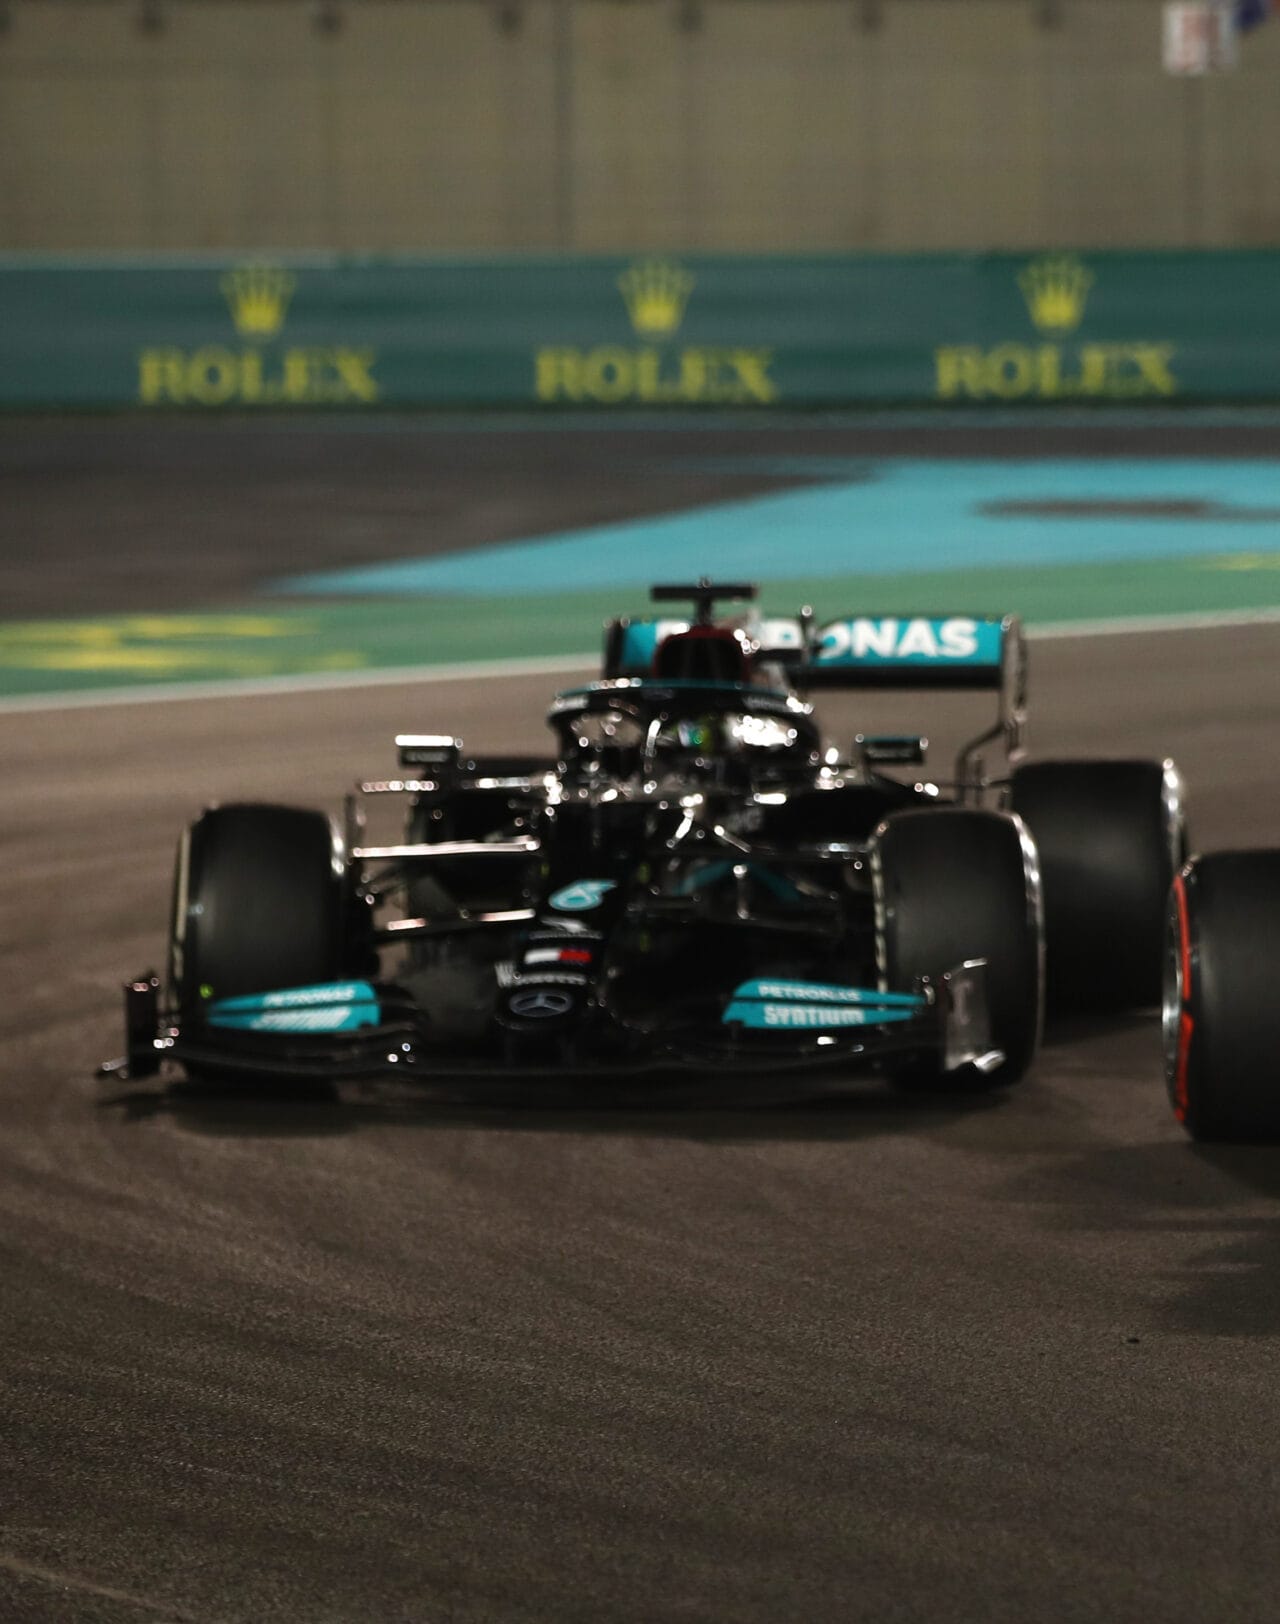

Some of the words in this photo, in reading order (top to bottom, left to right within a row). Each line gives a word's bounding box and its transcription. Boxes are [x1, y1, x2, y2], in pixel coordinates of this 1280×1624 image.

[139, 346, 379, 402] ROLEX
[536, 346, 777, 401] ROLEX
[935, 341, 1177, 398] ROLEX
